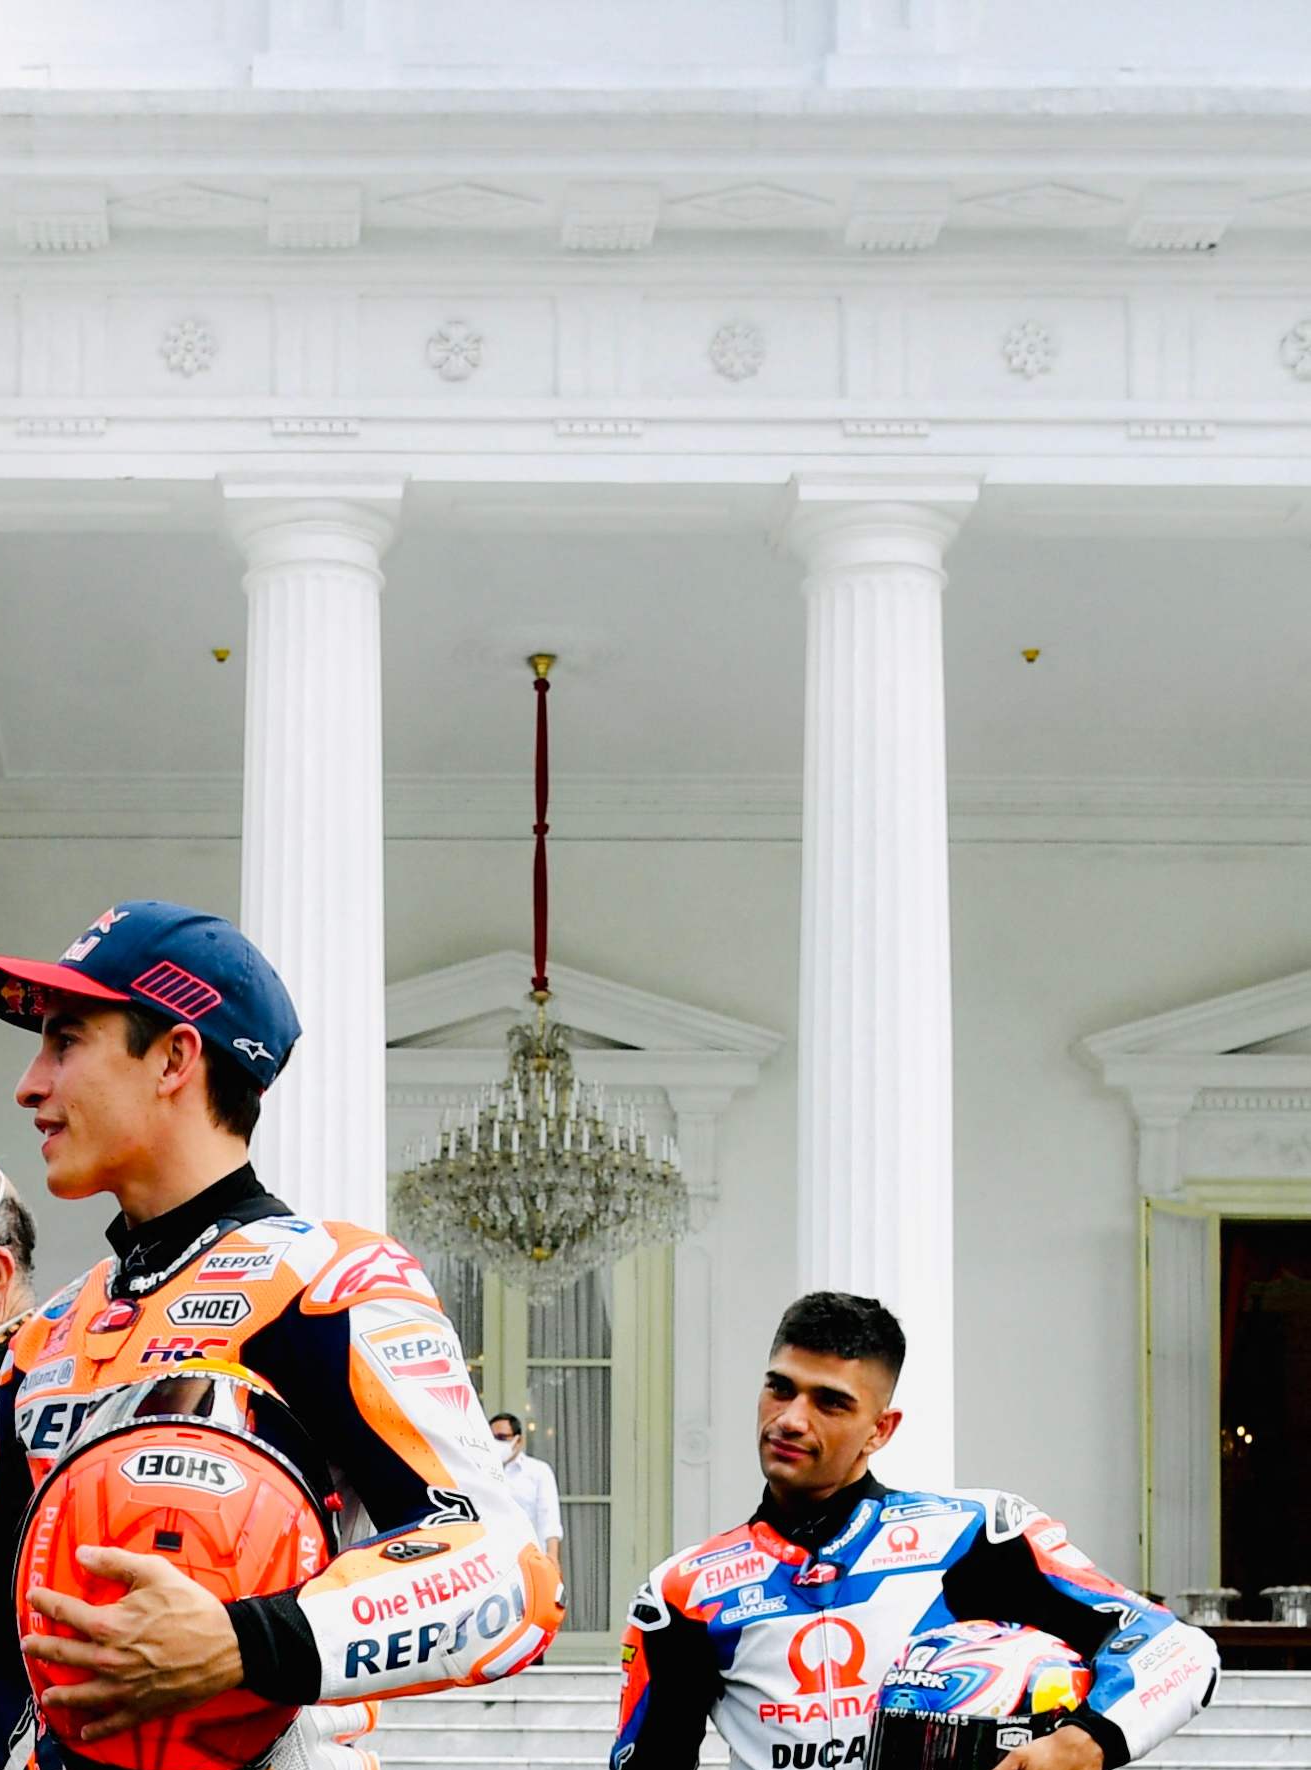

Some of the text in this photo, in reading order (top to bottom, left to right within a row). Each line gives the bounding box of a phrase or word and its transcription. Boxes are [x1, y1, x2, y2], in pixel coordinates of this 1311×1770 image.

[204, 1253, 275, 1270] REPSOL
[176, 1299, 241, 1320] SHOEI
[382, 1339, 460, 1361] REPSOL
[136, 1454, 228, 1487] SHOEI
[871, 1550, 940, 1566] PRAMAC
[704, 1555, 766, 1590] FIAMM
[351, 1592, 409, 1626] One
[722, 1598, 787, 1623] SHARK
[883, 1669, 952, 1691] SHARK
[759, 1692, 881, 1724] PRAMA
[883, 1706, 970, 1727] YOU WINGS
[771, 1735, 868, 1770] DUCA
